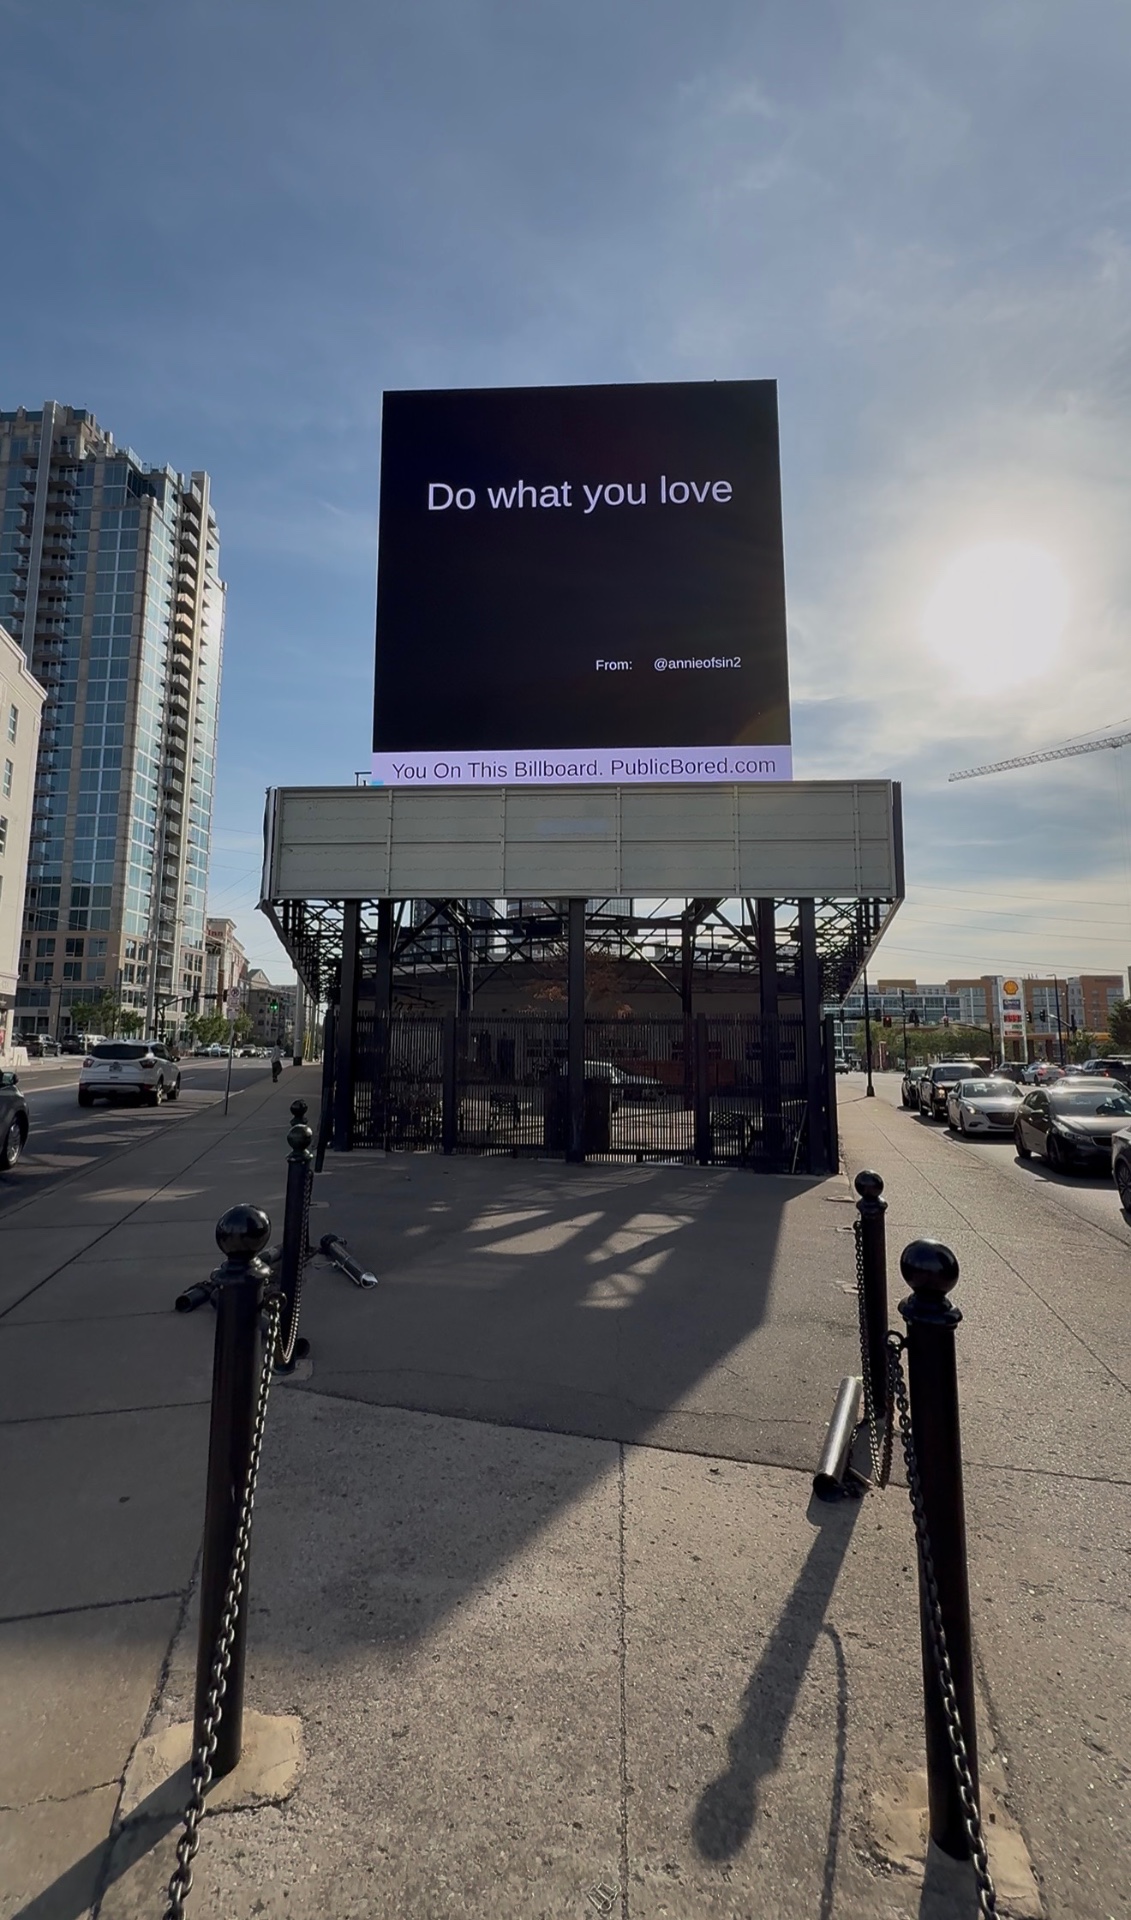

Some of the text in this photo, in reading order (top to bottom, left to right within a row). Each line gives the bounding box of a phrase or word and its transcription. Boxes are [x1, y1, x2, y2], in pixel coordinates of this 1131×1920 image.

[427, 475, 733, 514] Do what you love
[595, 656, 742, 671] From: @annieofsin2
[391, 757, 776, 780] You On This Billboard. PublicBored.com
